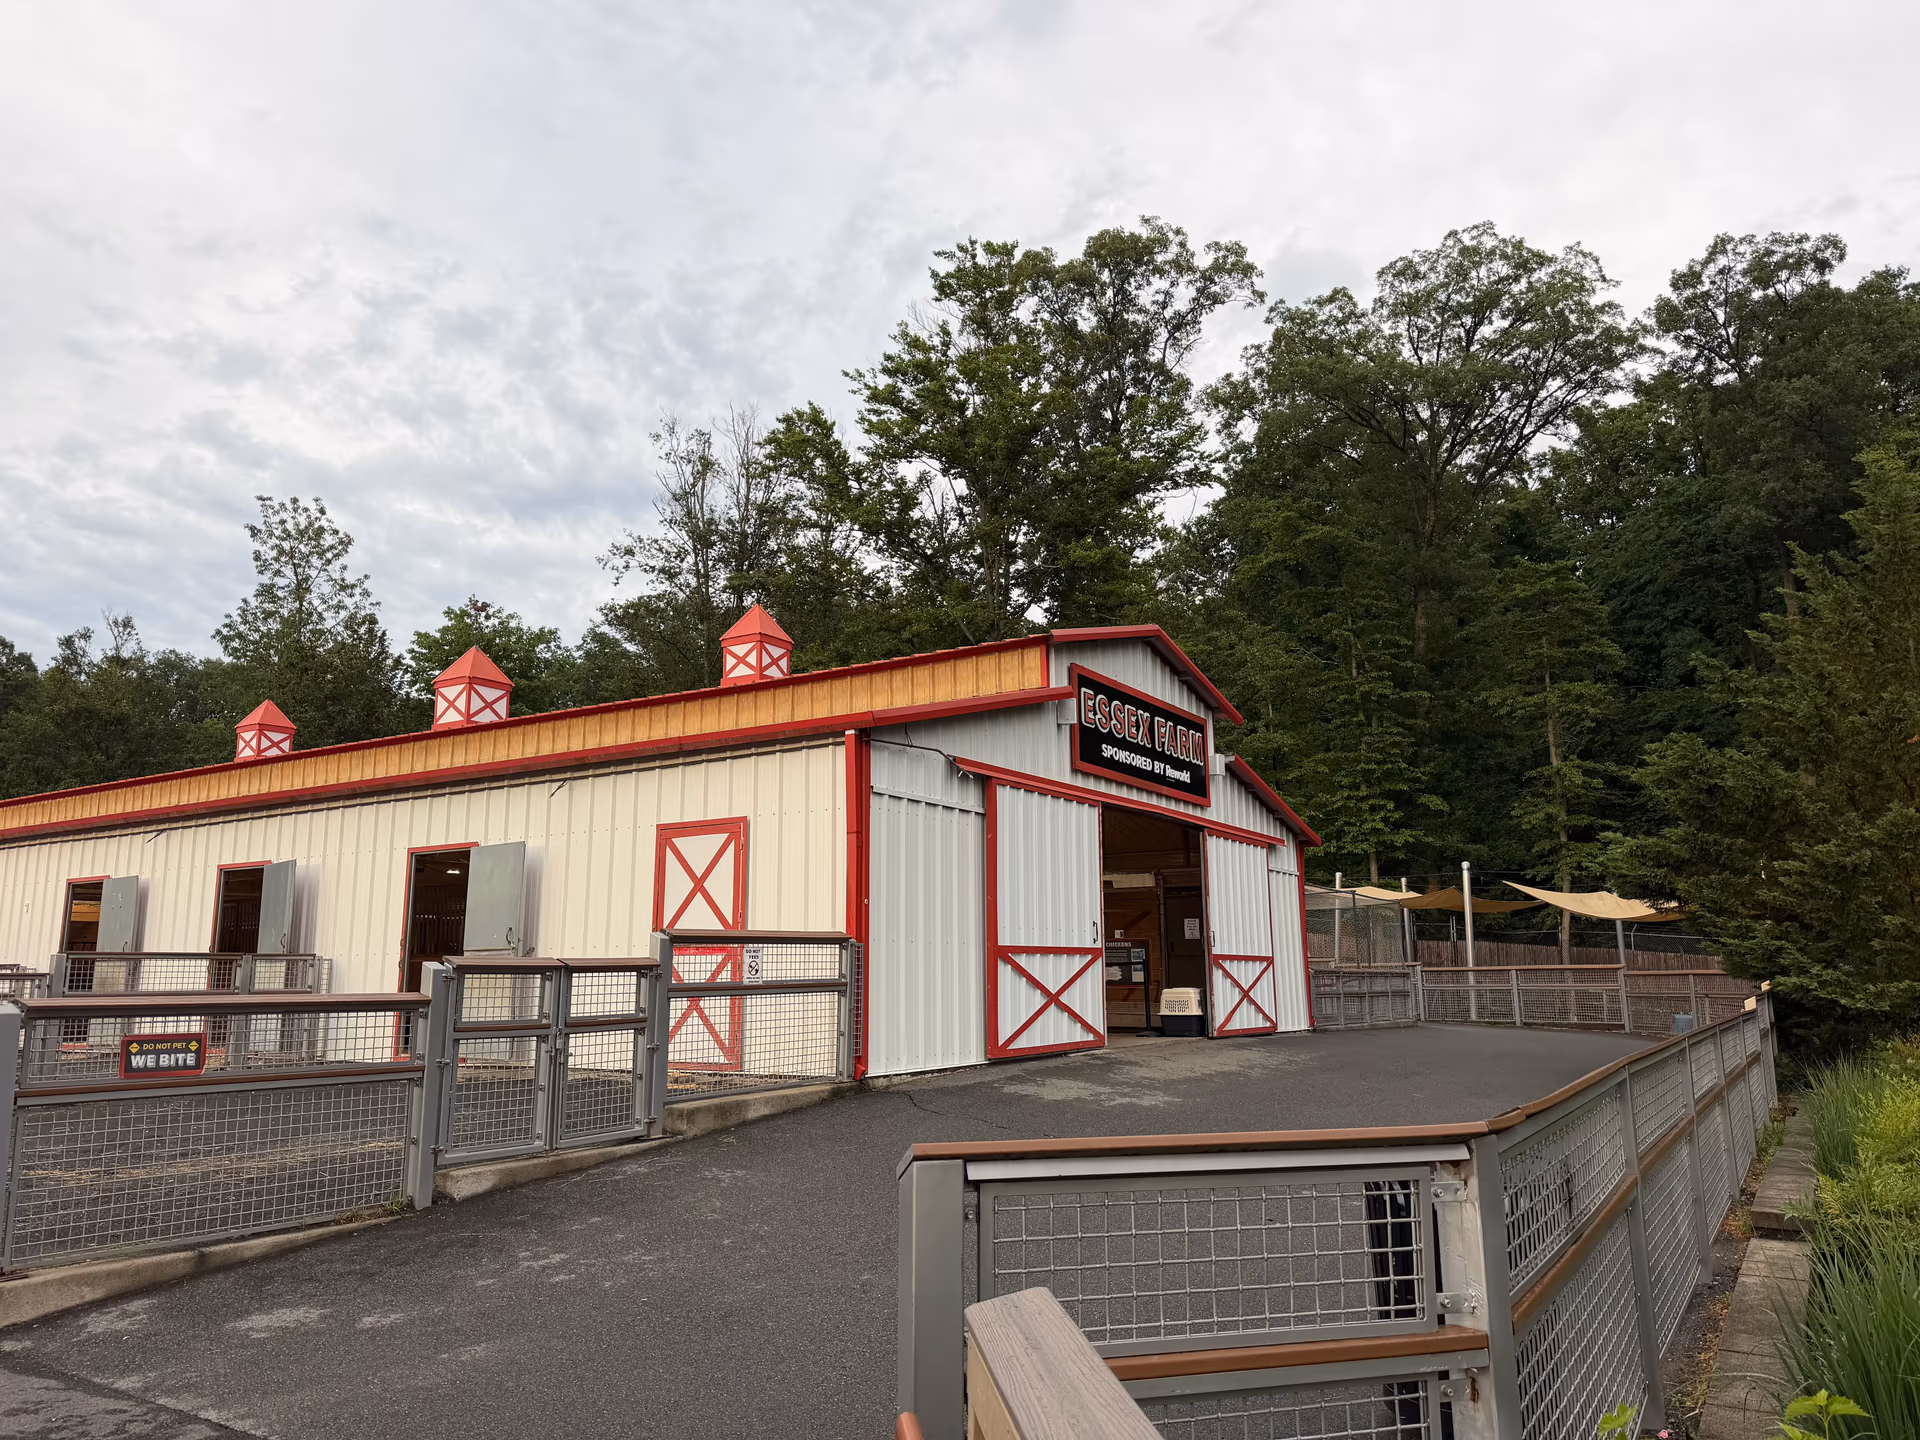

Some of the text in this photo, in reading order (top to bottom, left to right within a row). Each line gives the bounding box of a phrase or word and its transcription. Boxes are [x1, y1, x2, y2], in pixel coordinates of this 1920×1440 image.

[1081, 687, 1204, 766] ESSEX FARM
[1101, 744, 1152, 771] SPONSORED
[1154, 760, 1166, 775] BY
[130, 1053, 196, 1069] WE BITE
